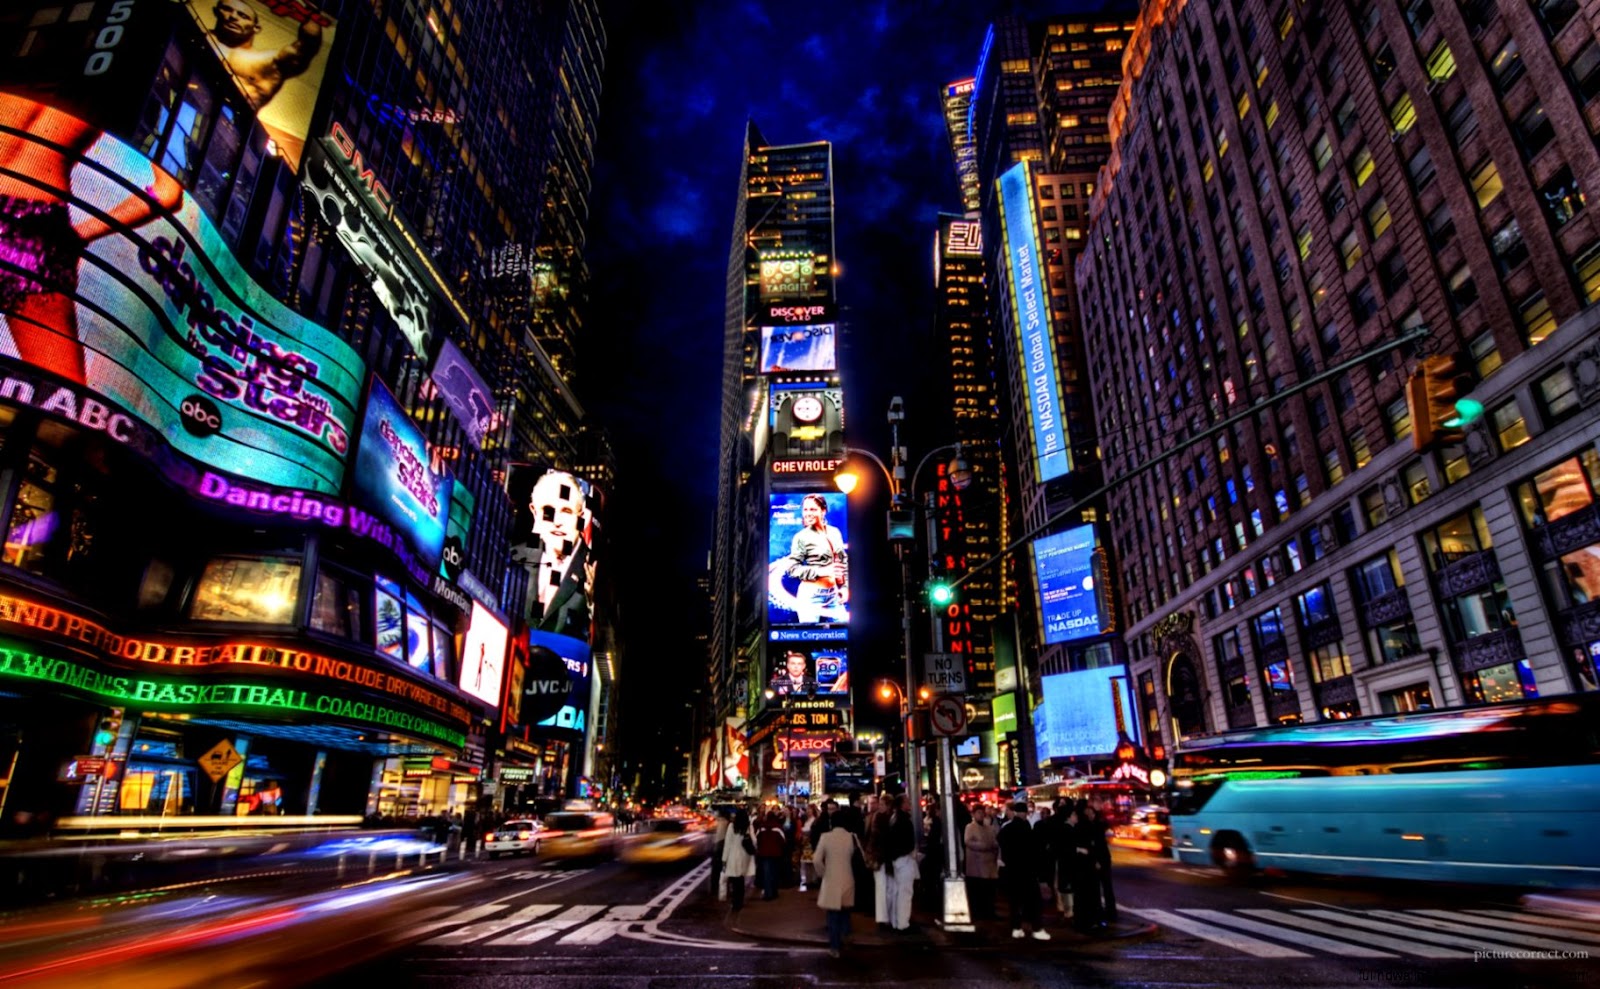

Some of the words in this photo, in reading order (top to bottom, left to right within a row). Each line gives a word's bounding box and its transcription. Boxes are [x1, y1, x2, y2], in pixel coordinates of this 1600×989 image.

[84, 0, 135, 75] 500
[332, 122, 390, 214] GMC
[765, 282, 809, 293] TARGET
[1016, 242, 1034, 290] Market
[770, 306, 825, 317] DISCOVER
[1023, 287, 1041, 331] Select
[1028, 330, 1047, 373] Global
[40, 387, 135, 443] ABC
[180, 400, 221, 430] abc
[1034, 372, 1055, 432] NASDAQ
[1044, 432, 1058, 462] The
[199, 470, 345, 527] Dancing
[349, 505, 393, 549] With
[1071, 608, 1082, 618] UP
[64, 617, 102, 647] PET
[276, 647, 312, 672] TO
[314, 655, 385, 690] INCLUDE
[780, 631, 799, 640] News
[801, 630, 846, 642] Corporation
[928, 671, 963, 685] TURNS
[935, 658, 953, 670] NO
[24, 653, 129, 697] WOMEN'S
[135, 679, 315, 712] BASKETBALL
[316, 695, 376, 721] COACH
[525, 680, 560, 695] JVC
